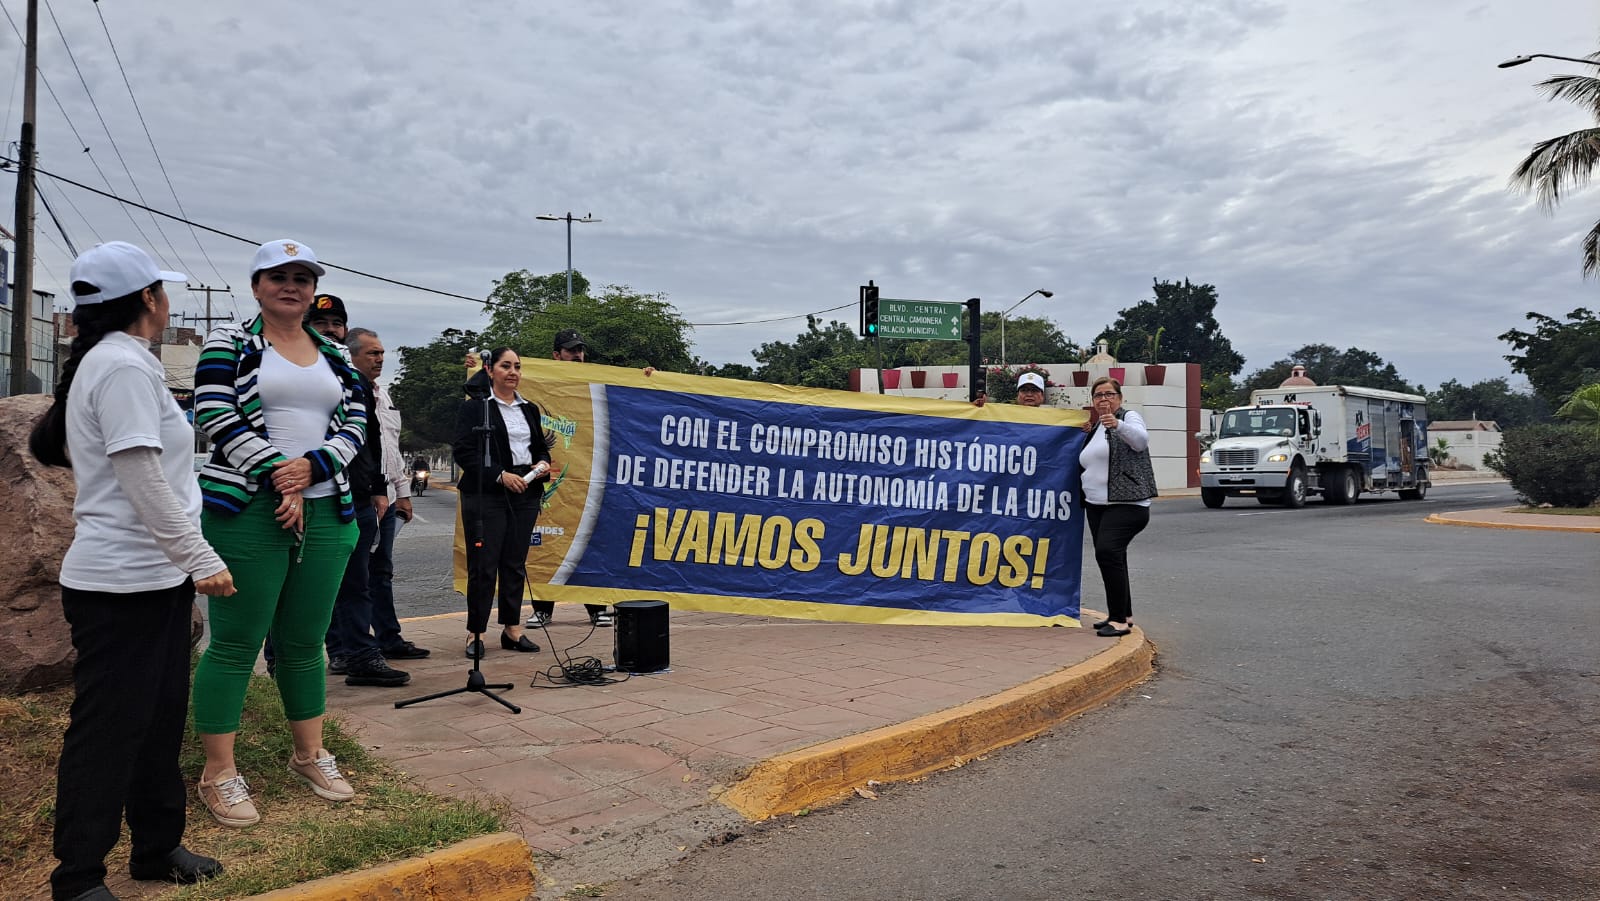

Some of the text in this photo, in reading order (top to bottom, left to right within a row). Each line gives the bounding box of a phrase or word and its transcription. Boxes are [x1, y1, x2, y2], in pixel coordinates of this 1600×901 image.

[880, 314, 942, 325] CENTRAL CAMIONERA
[889, 303, 948, 315] BLVD. CENTRAL
[880, 325, 939, 336] PALACIO MUNICIPAL
[660, 414, 1037, 476] CON EL COMPROMISO HISTÓRICO
[616, 454, 1072, 521] DE DEFENDER LA AUTONOMÍA DE LA UAS
[628, 507, 1051, 590] ¡VAMOS JUNTOS!
